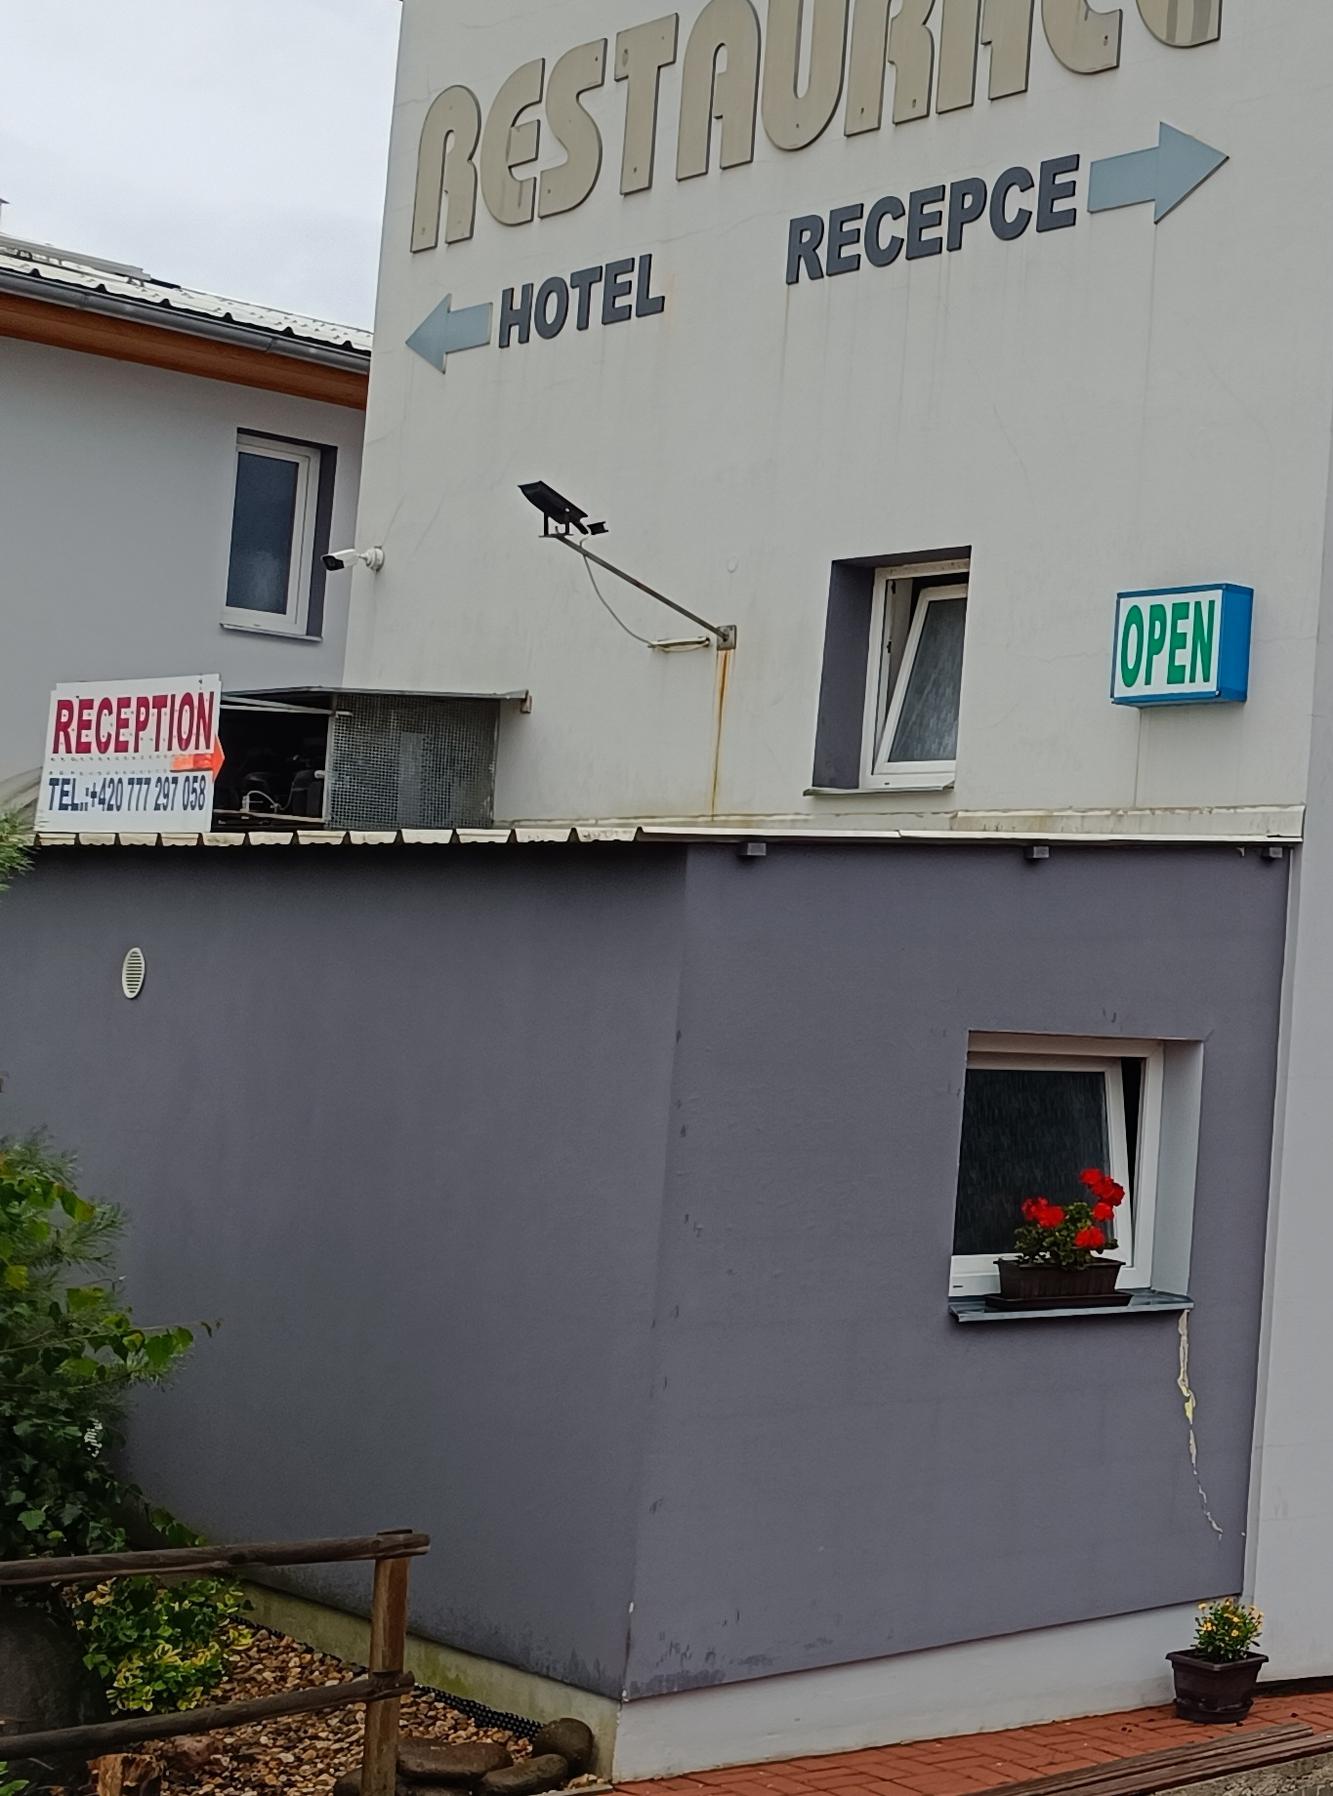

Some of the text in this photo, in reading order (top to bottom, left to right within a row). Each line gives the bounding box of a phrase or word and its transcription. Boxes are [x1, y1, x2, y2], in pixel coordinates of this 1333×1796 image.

[410, 0, 1221, 253] RESTAURA
[786, 153, 1081, 285] RECEPCE
[497, 253, 666, 350] HOTEL
[1121, 600, 1215, 687] OPEN
[52, 691, 214, 754] RECEPTION
[127, 776, 152, 811] 777
[154, 776, 178, 811] 297
[182, 775, 207, 811] 058
